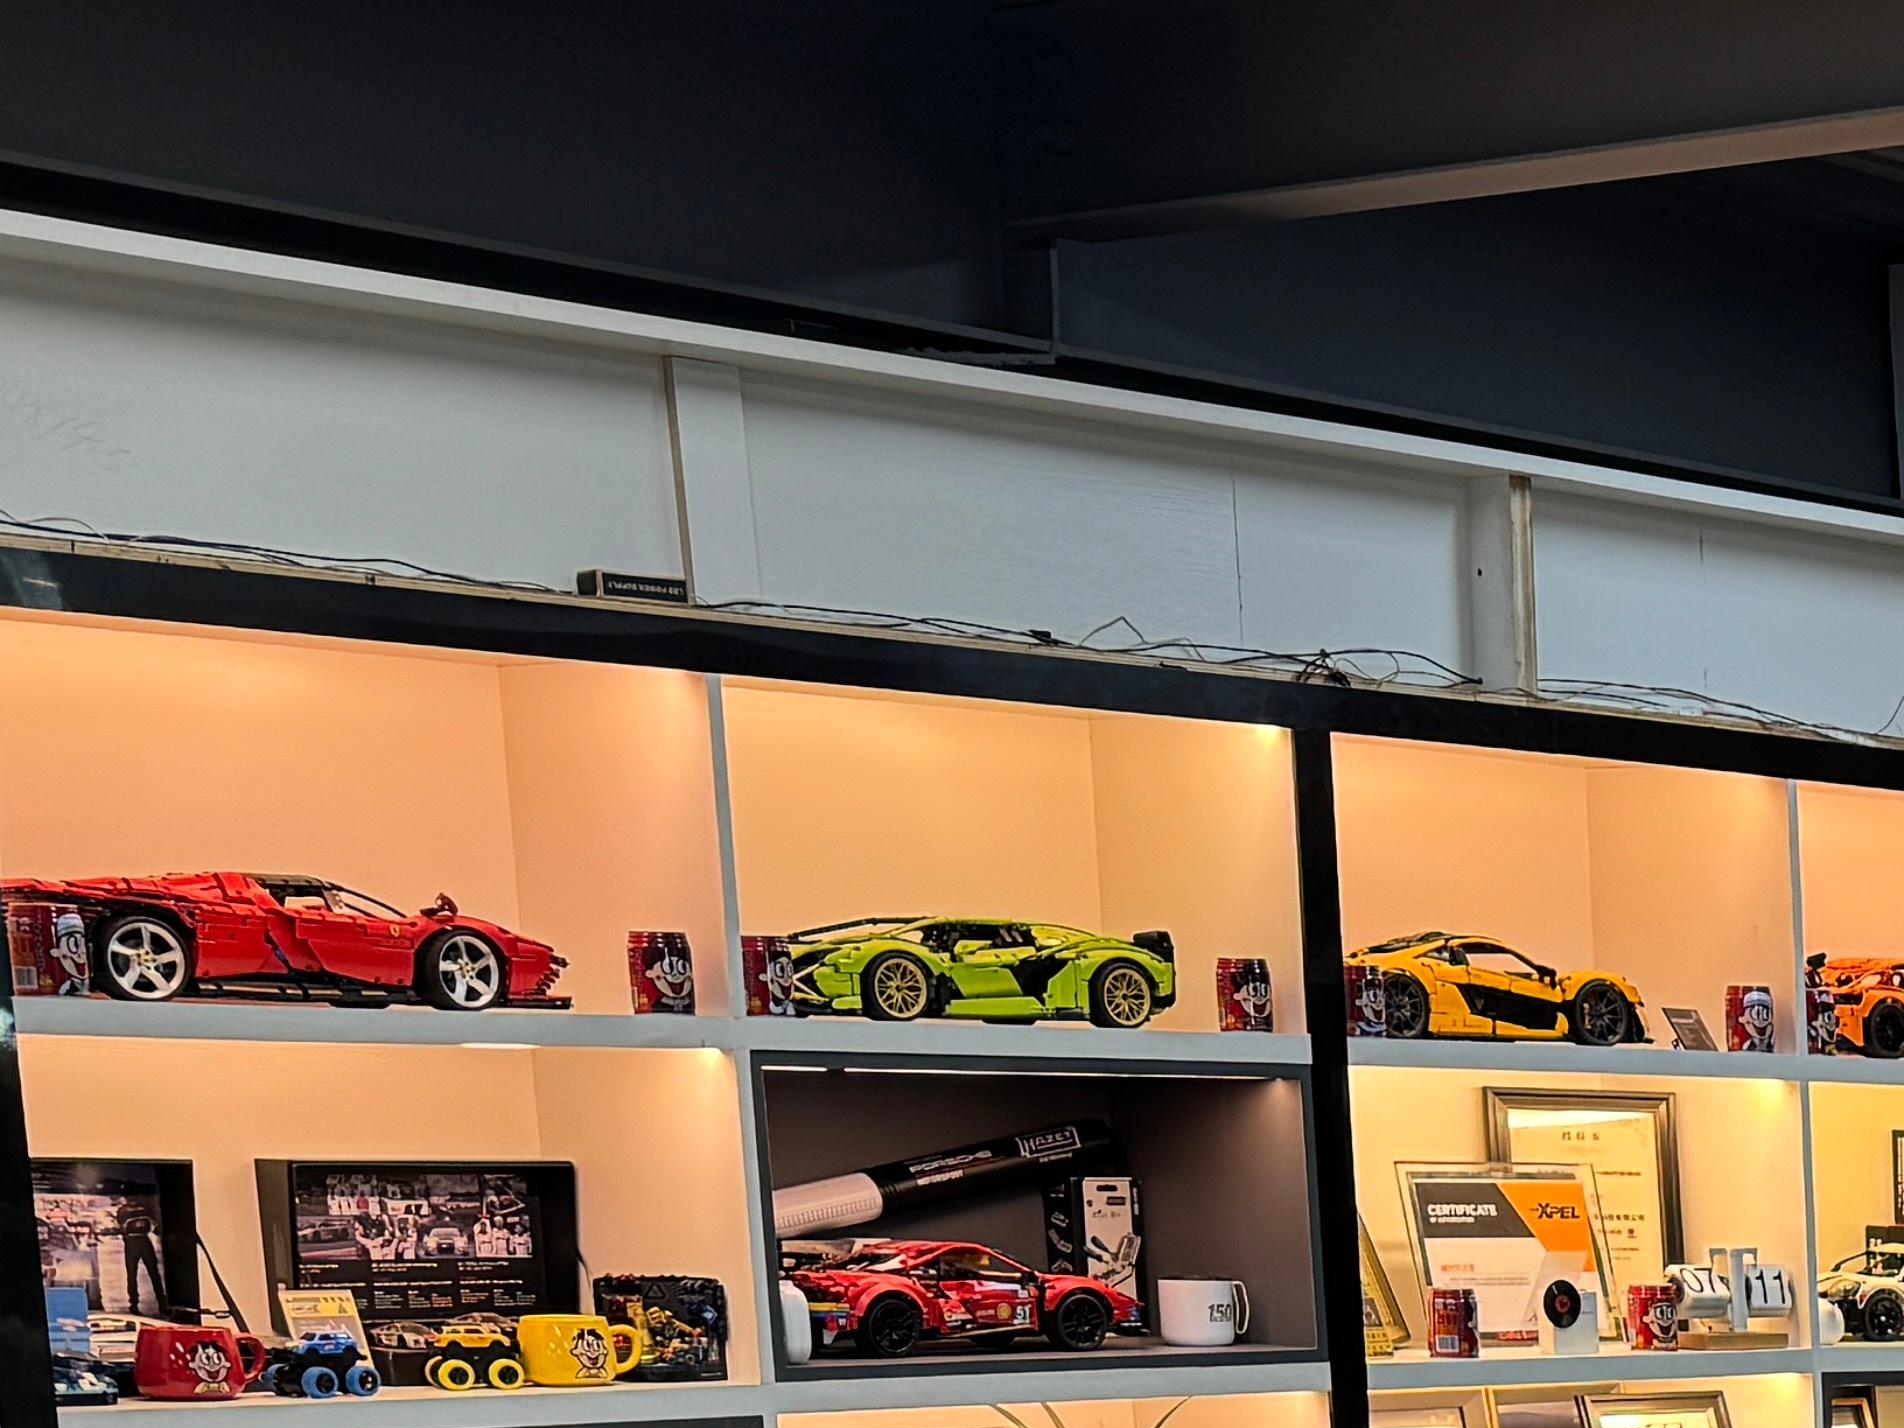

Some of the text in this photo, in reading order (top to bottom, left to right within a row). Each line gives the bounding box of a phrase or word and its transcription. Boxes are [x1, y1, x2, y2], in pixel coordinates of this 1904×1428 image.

[1021, 1131, 1074, 1157] HAZET
[1427, 1204, 1498, 1217] CERTIFICATE
[1680, 1267, 1717, 1294] 07
[1755, 1269, 1786, 1305] 11
